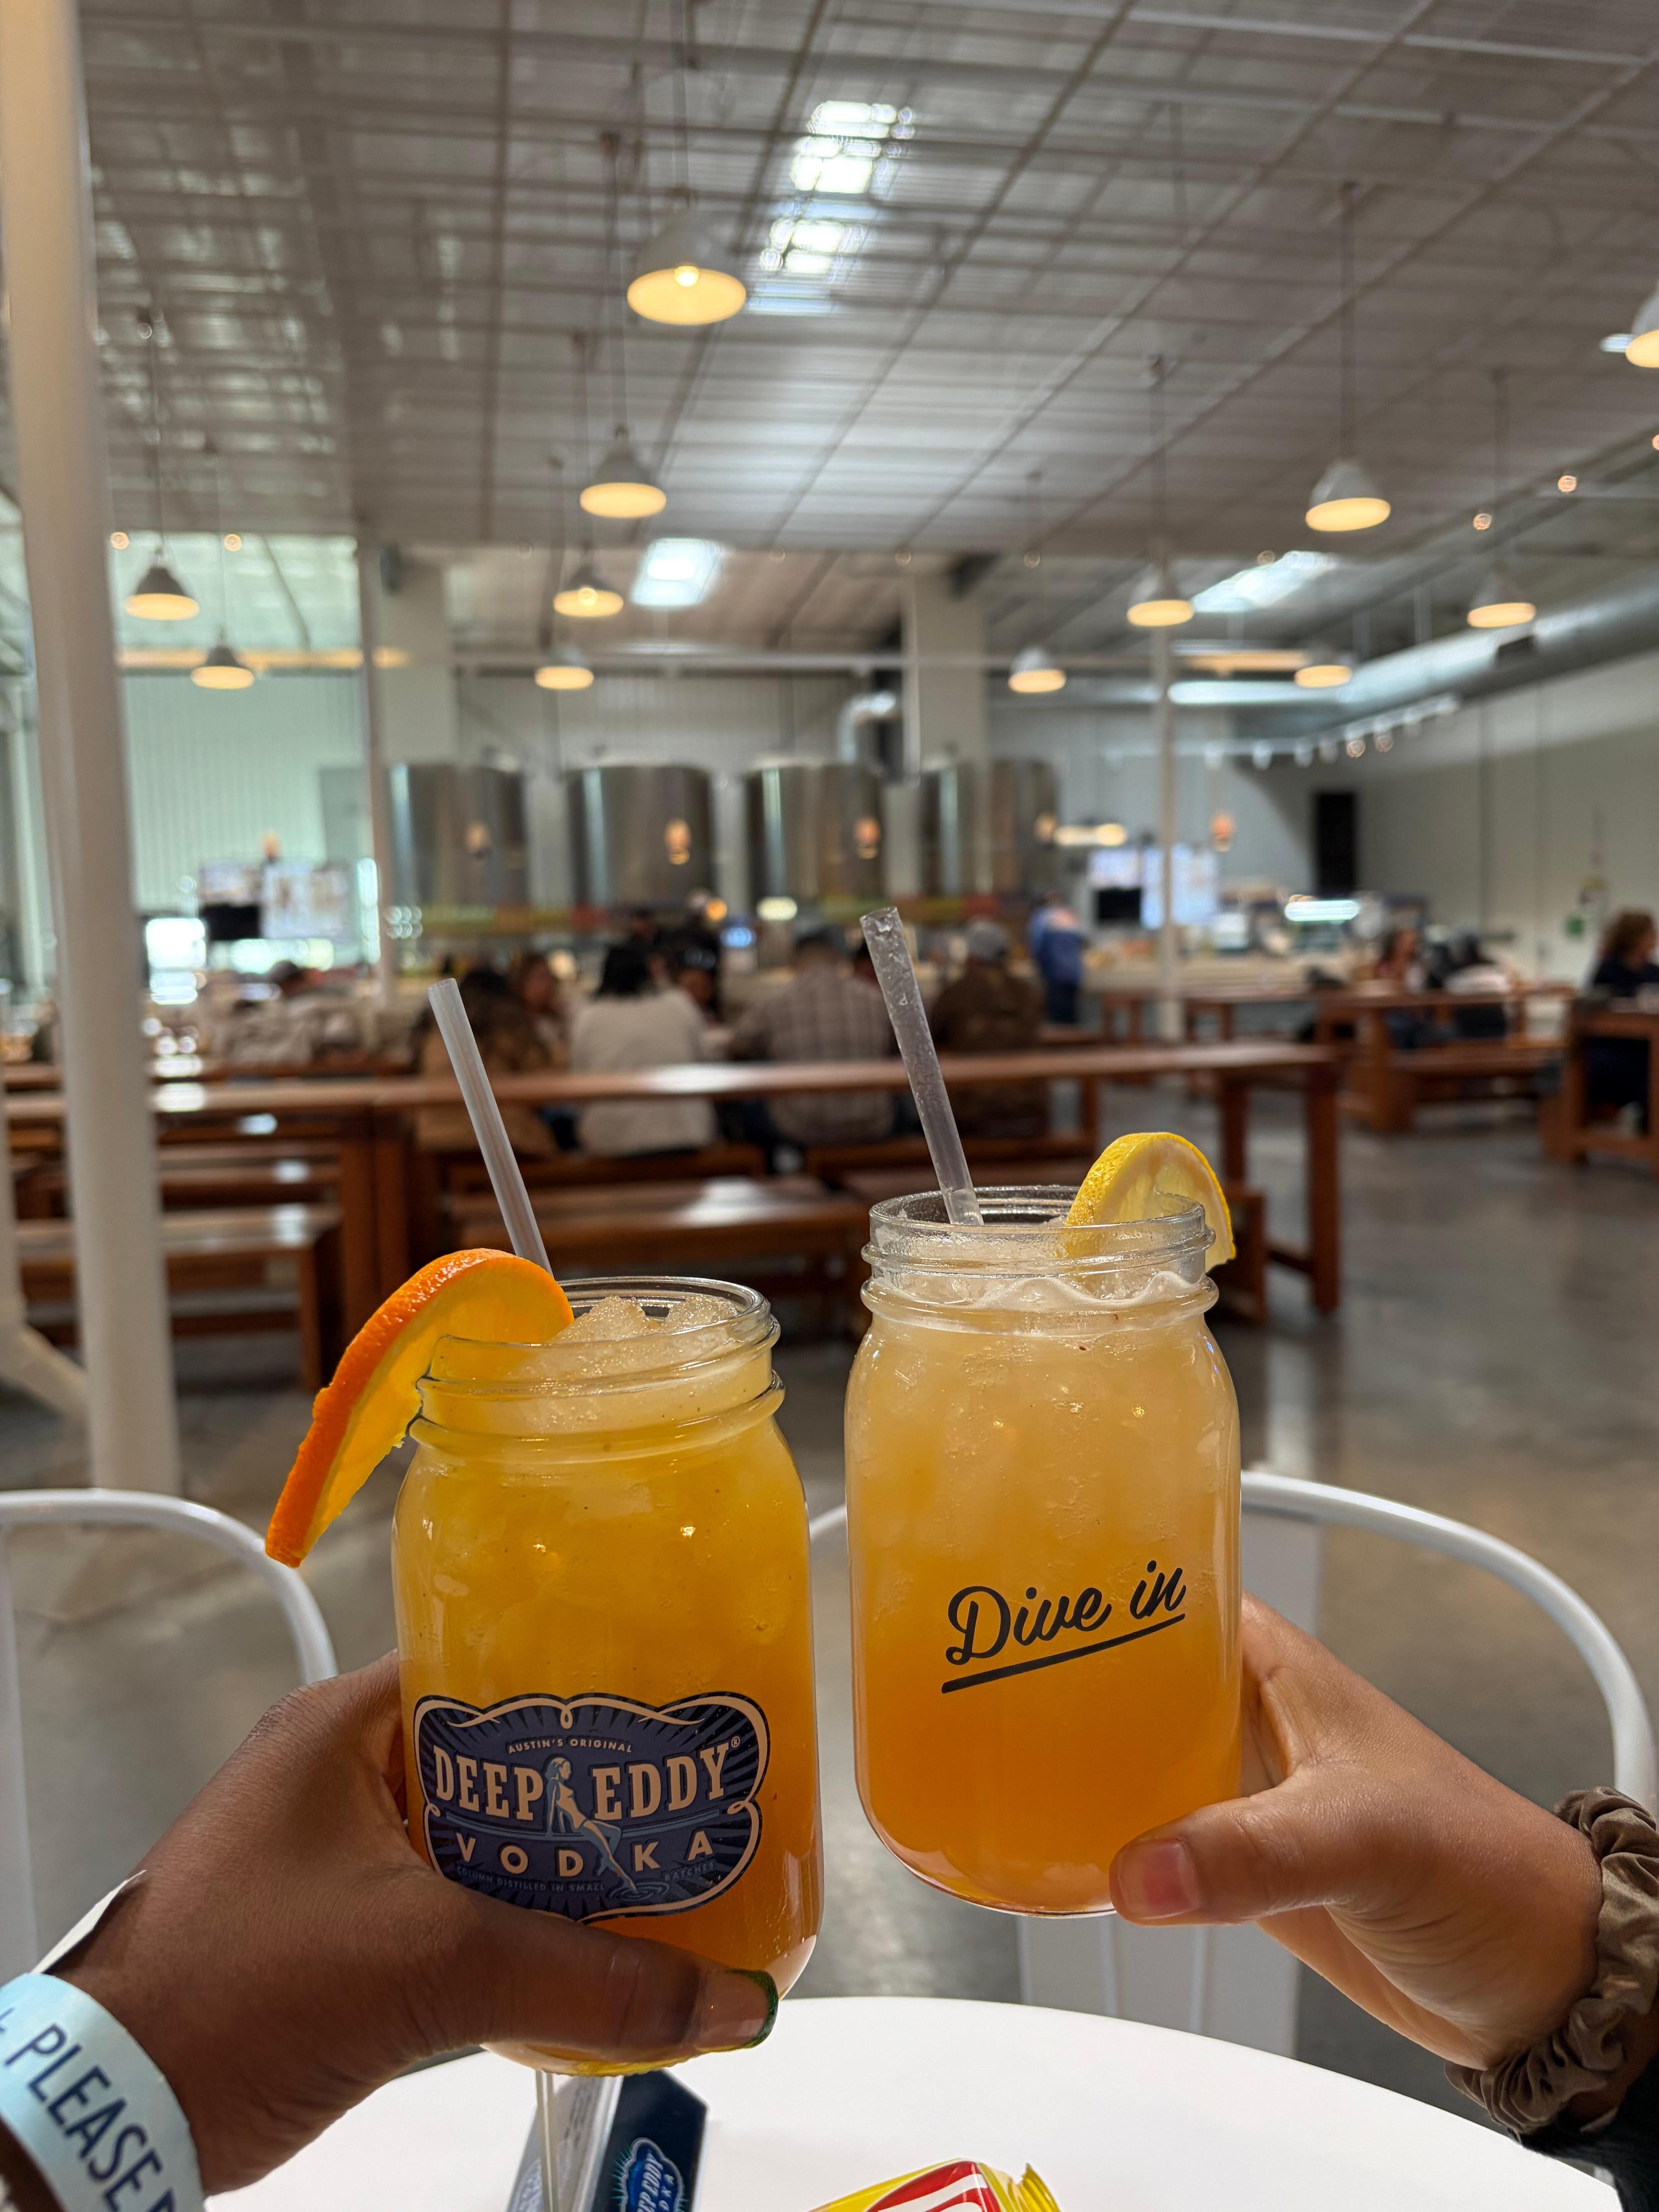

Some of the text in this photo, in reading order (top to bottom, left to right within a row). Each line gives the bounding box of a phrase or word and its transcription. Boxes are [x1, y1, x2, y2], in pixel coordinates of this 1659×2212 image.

[946, 1560, 1187, 1665] Dive in
[433, 1745, 544, 1822] DEEP
[509, 1738, 632, 1754] AUSTIN'S ORIGINAL
[457, 1866, 493, 1883] COLUMN
[498, 1878, 546, 1891] DISTILLED
[570, 1883, 605, 1891] SMALL
[665, 1861, 714, 1881] BATCHES
[4, 2022, 163, 2212] PLEASE
